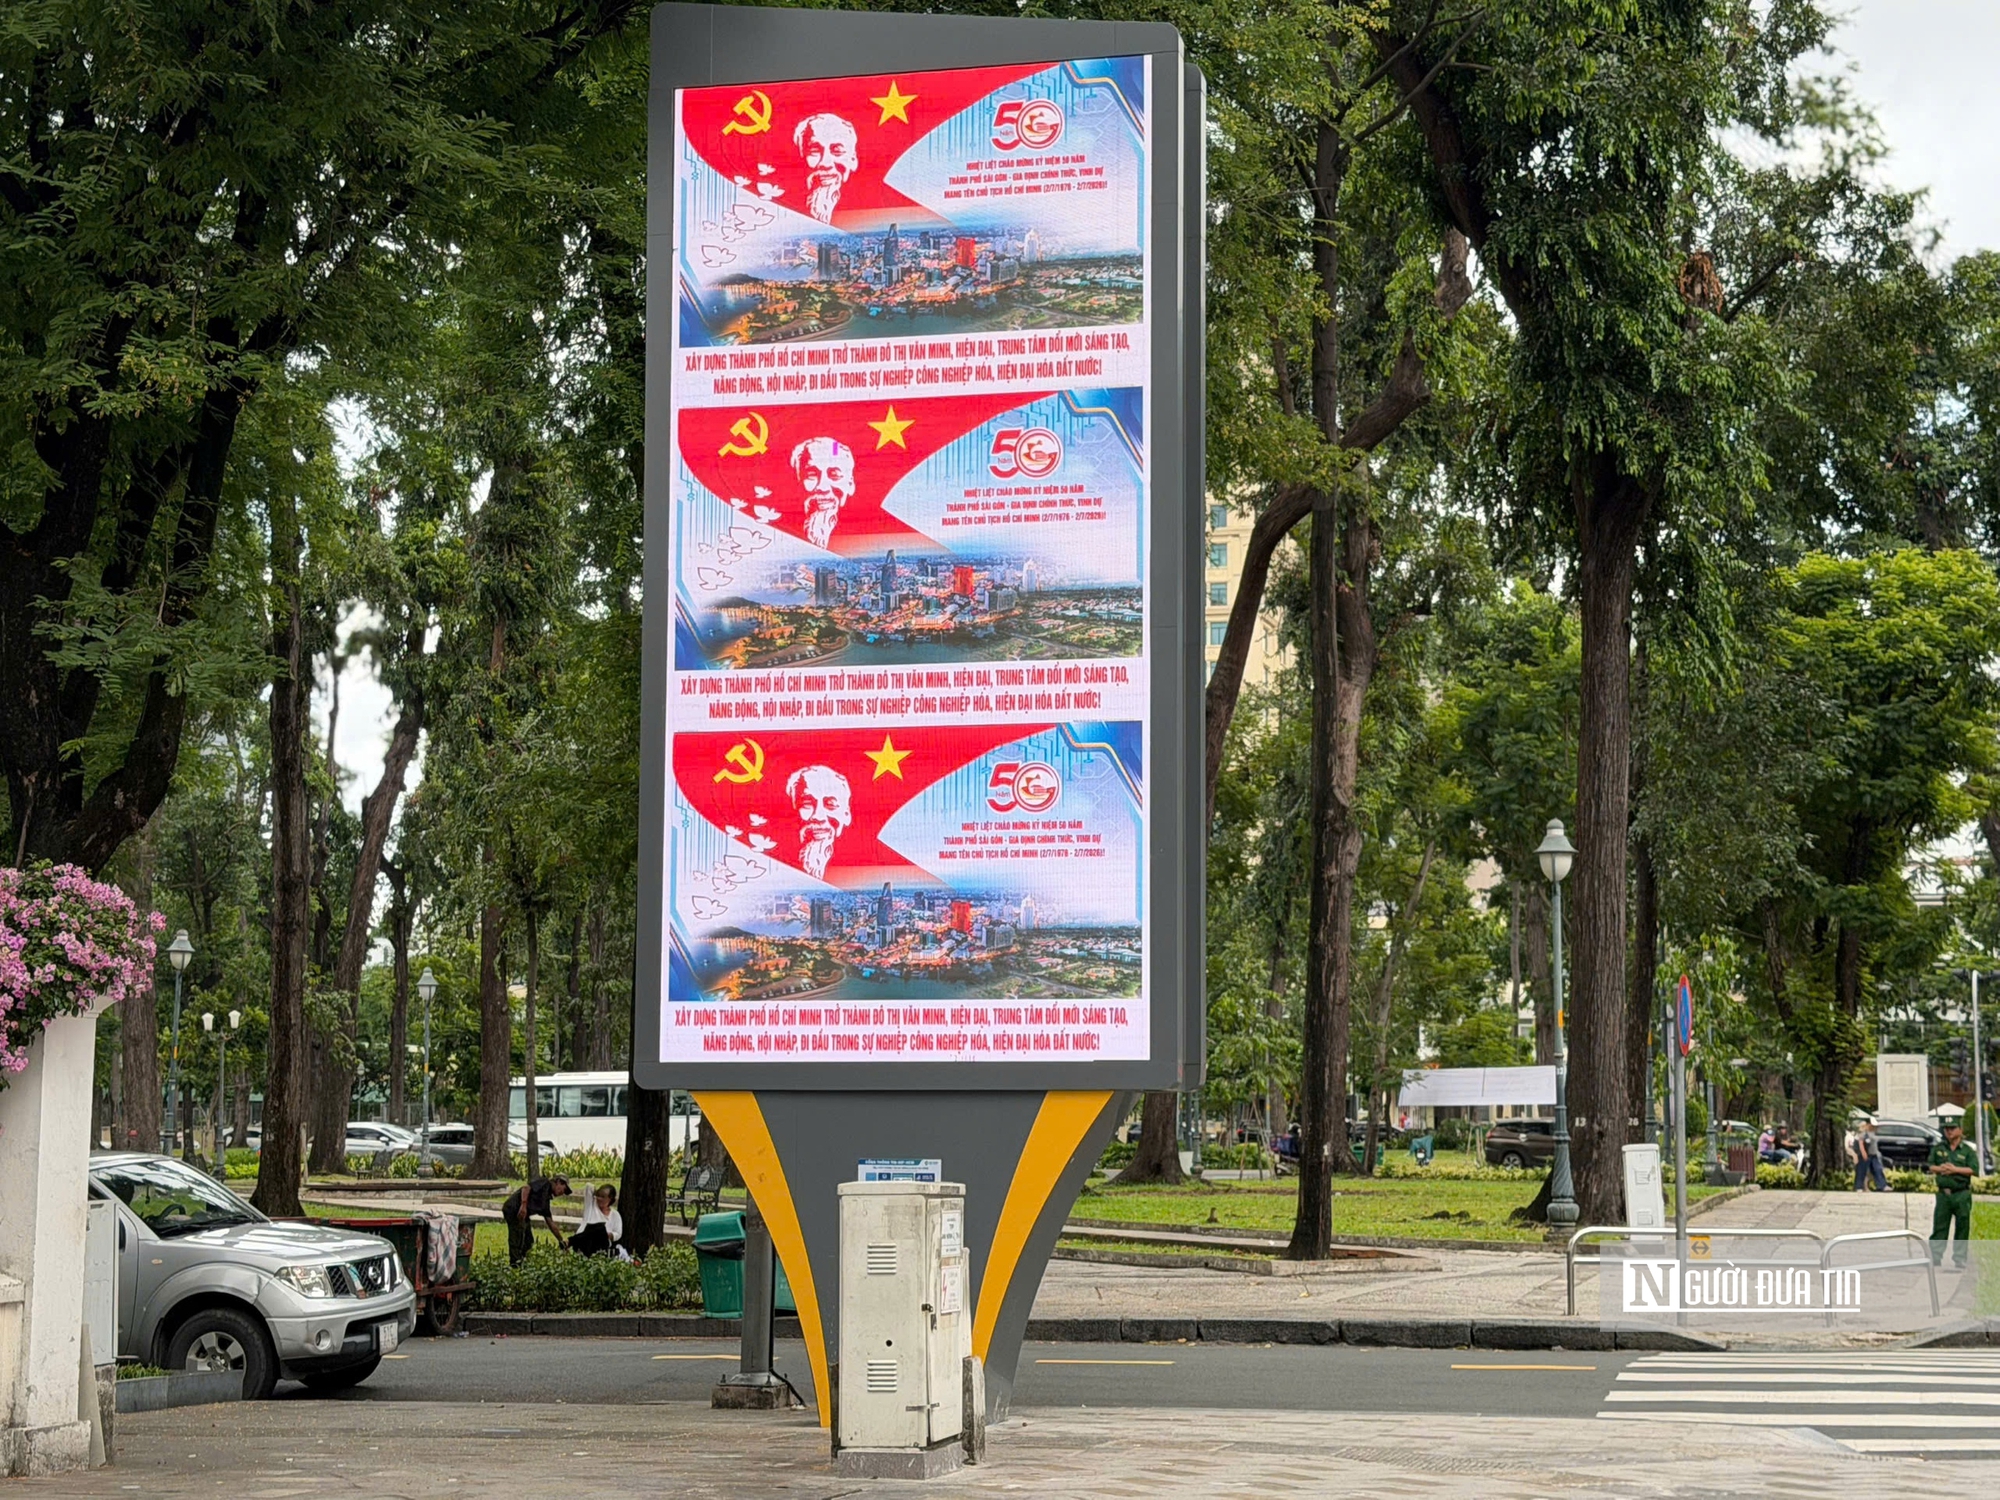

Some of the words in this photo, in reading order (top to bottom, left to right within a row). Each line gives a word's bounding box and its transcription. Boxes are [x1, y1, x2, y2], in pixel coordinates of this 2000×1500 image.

[686, 350, 701, 371] XÂY
[704, 349, 726, 373] DỰNG
[729, 347, 756, 369] THÀNH
[759, 346, 774, 367] PHỐ
[778, 345, 788, 366] HỒ
[791, 345, 805, 365] CHÍ
[808, 348, 829, 365] MINH
[832, 342, 848, 363] TRỞ
[850, 341, 877, 362] THÀNH
[880, 341, 891, 361] ĐÔ
[894, 344, 906, 364] THỊ
[909, 339, 926, 359] VĂN
[929, 341, 953, 359] MINH,
[956, 337, 975, 360] HIỆN
[979, 339, 995, 359] ĐẠI,
[998, 338, 1025, 355] TRUNG
[1028, 333, 1046, 353] TÂM
[1050, 331, 1062, 352] ĐỔI
[1066, 330, 1082, 351] MỚI
[1085, 330, 1109, 350] SÁNG
[1111, 332, 1129, 352] TẠO,
[714, 373, 736, 394] NĂNG
[740, 371, 764, 396] ĐỘNG,
[767, 370, 780, 395] HỘI
[784, 369, 806, 394] NHẬP,
[810, 373, 818, 389] ĐI
[821, 367, 836, 388] ĐẦU
[840, 370, 866, 387] TRONG
[870, 366, 881, 389] SỰ
[883, 364, 913, 388] NGHIỆP
[916, 363, 939, 383] CÔNG
[942, 361, 972, 385] NGHIỆP
[975, 360, 994, 382] HÓA,
[998, 359, 1017, 382] HIỆN
[1020, 362, 1034, 381] ĐẠI
[1037, 357, 1053, 377] HÓA
[1057, 355, 1072, 376] ĐẤT
[681, 674, 697, 695] XÂY
[700, 674, 722, 698] DỰNG
[725, 673, 751, 693] THÀNH
[755, 671, 771, 692] PHỐ
[774, 671, 785, 692] HỒ
[788, 671, 801, 692] CHÍ
[805, 675, 826, 691] MINH
[829, 669, 844, 690] TRỞ
[848, 669, 874, 690] THÀNH
[877, 669, 888, 689] ĐÔ
[891, 672, 904, 692] THỊ
[907, 668, 923, 688] VĂN
[926, 671, 951, 689] MINH,
[954, 667, 973, 690] HIỆN
[976, 670, 993, 690] ĐẠI,
[996, 669, 1023, 685] TRUNG
[1027, 664, 1045, 685] TÂM
[1047, 663, 1061, 684] ĐỔI
[1065, 662, 1081, 683] MỚI
[1084, 663, 1107, 683] SÁNG
[1110, 666, 1128, 686] TẠO,
[709, 698, 732, 718] NĂNG
[735, 696, 760, 721] ĐỘNG,
[763, 695, 777, 720] HỘI
[779, 695, 803, 720] NHẬP,
[806, 699, 814, 715] ĐI
[817, 694, 833, 715] ĐẦU
[836, 698, 863, 715] TRONG
[866, 694, 878, 717] SỰ
[880, 693, 910, 717] NGHIỆP
[914, 692, 936, 713] CÔNG
[939, 692, 970, 715] NGHIỆP
[973, 691, 992, 713] HÓA,
[996, 690, 1015, 714] HIỆN
[1018, 694, 1032, 713] ĐẠI
[1035, 689, 1051, 709] HÓA
[1055, 688, 1071, 709] ĐẤT
[675, 1006, 691, 1026] XÂY
[694, 1006, 716, 1029] DỰNG
[719, 1006, 746, 1026] THÀNH
[750, 1005, 766, 1025] PHỐ
[769, 1005, 779, 1025] HỒ
[782, 1005, 796, 1025] CHÍ
[799, 1009, 821, 1025] MINH
[824, 1004, 840, 1025] TRỞ
[843, 1005, 870, 1025] THÀNH
[873, 1005, 884, 1025] ĐÔ
[887, 1009, 900, 1029] THỊ
[903, 1005, 920, 1025] VĂN
[923, 1009, 948, 1027] MINH,
[951, 1005, 970, 1028] HIỆN
[974, 1009, 990, 1028] ĐẠI,
[993, 1008, 1021, 1024] TRUNG
[1025, 1004, 1042, 1024] TÂM
[1046, 1003, 1060, 1024] ĐỔI
[1063, 1003, 1079, 1024] MỚI
[1083, 1004, 1106, 1024] SÁNG
[1109, 1008, 1128, 1027] TẠO,
[704, 1030, 726, 1050] NĂNG
[729, 1029, 755, 1054] ĐỘNG,
[758, 1029, 771, 1054] HỘI
[774, 1029, 798, 1054] NHẬP,
[801, 1034, 809, 1050] ĐI
[812, 1029, 829, 1050] ĐẦU
[832, 1034, 859, 1050] TRONG
[862, 1030, 873, 1053] SỰ
[876, 1030, 907, 1053] NGHIỆP
[910, 1030, 933, 1050] CÔNG
[936, 1030, 967, 1053] NGHIỆP
[970, 1030, 990, 1052] HÓA,
[993, 1030, 1013, 1053] HIỆN
[1016, 1034, 1030, 1053] ĐẠI
[1033, 1030, 1050, 1049] HÓA
[1053, 1028, 1069, 1049] ĐẤT
